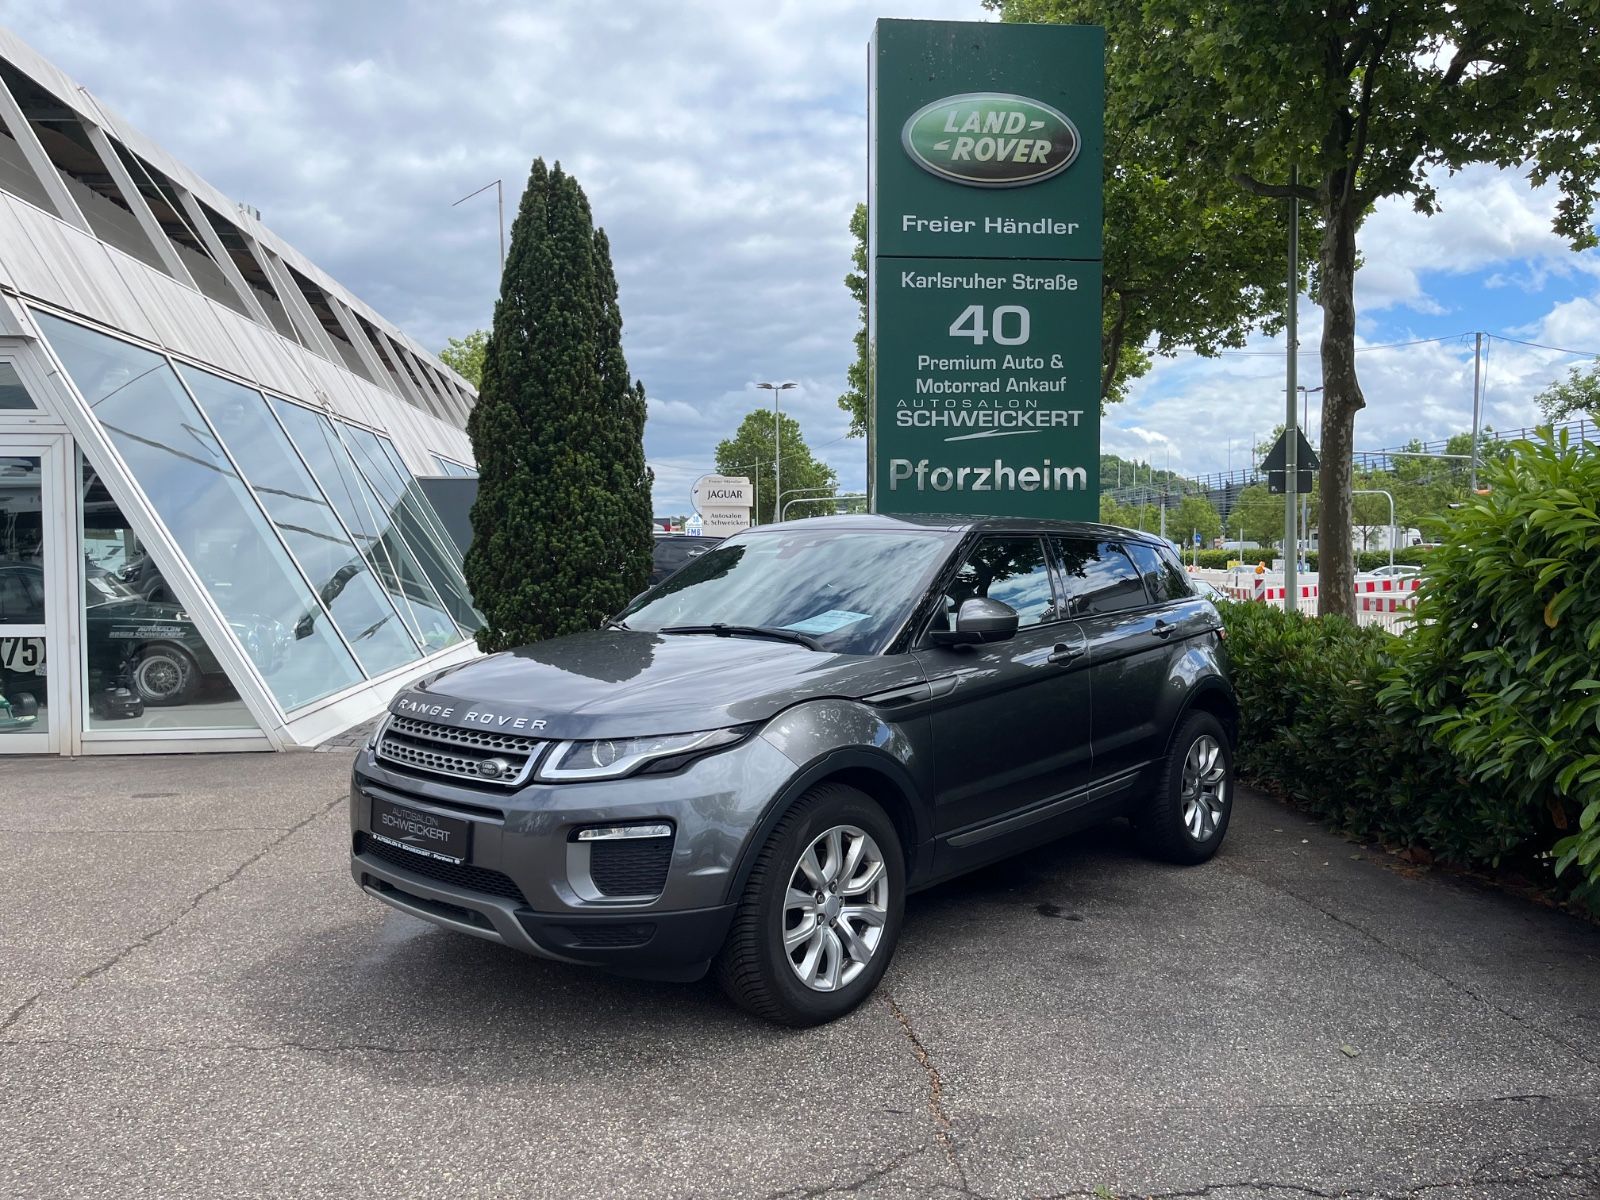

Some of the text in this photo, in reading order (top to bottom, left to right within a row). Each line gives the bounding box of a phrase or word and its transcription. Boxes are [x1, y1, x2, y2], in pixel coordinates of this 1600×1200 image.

[943, 111, 1027, 134] LAND
[951, 136, 1052, 164] ROVER
[902, 215, 1080, 235] Freier Händler
[901, 271, 1078, 291] Karlsruher Straße
[949, 304, 1031, 346] 40
[918, 354, 1064, 371] Premium Auto &
[916, 376, 1067, 394] Motorrad Ankauf
[896, 399, 1038, 408] AUTOSALON
[896, 410, 1084, 427] SCHWEICKERT
[889, 458, 1087, 492] Pforzheim
[707, 490, 743, 500] JAGUAR
[398, 699, 548, 730] RANGE ROVER
[392, 807, 439, 826] AUTOSALON
[382, 814, 451, 843] SCHWEICKERT
